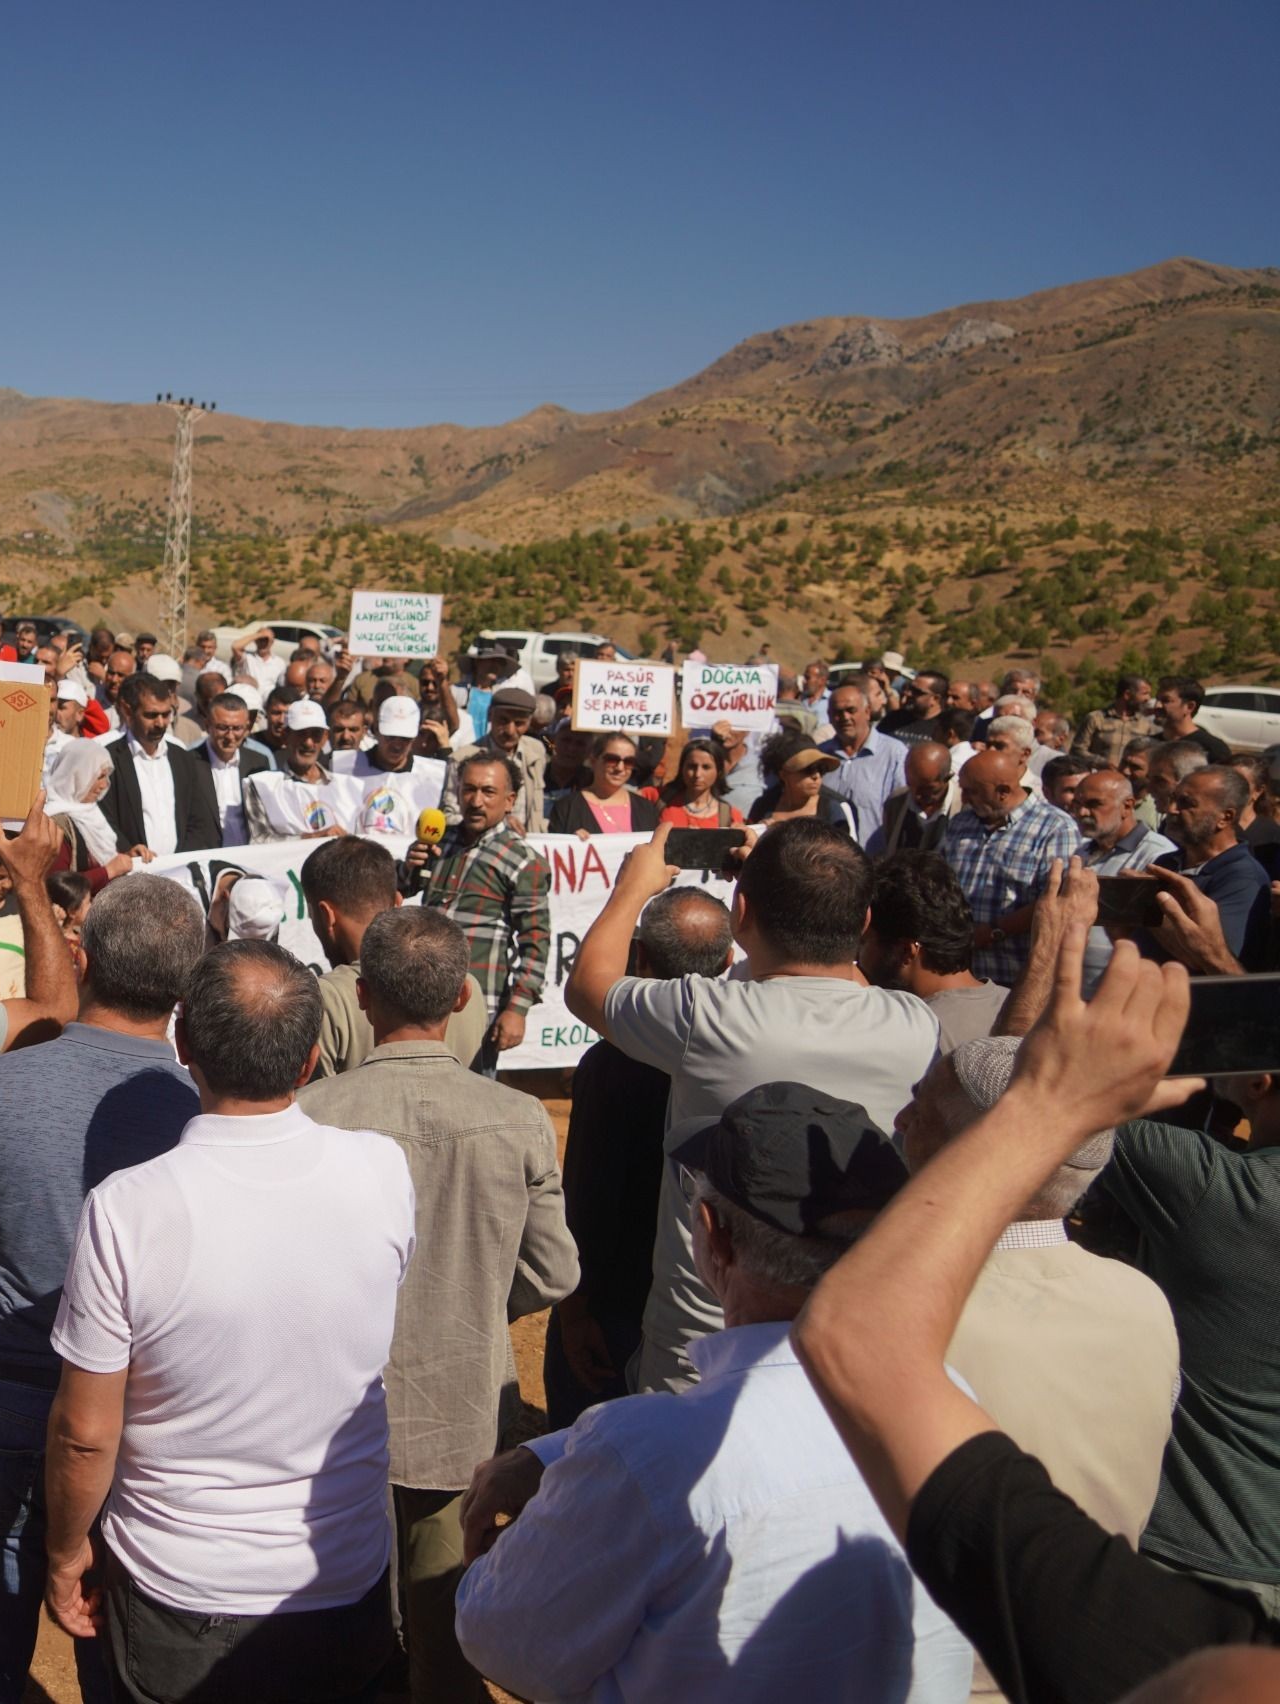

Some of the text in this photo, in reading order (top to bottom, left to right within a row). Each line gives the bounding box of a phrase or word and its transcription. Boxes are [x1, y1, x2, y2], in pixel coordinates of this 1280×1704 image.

[702, 666, 762, 684] DOĞAYA
[591, 683, 650, 697] YA ME YE
[584, 699, 648, 712] SERMAYE
[690, 688, 775, 712] ÖZGÜRLÜK
